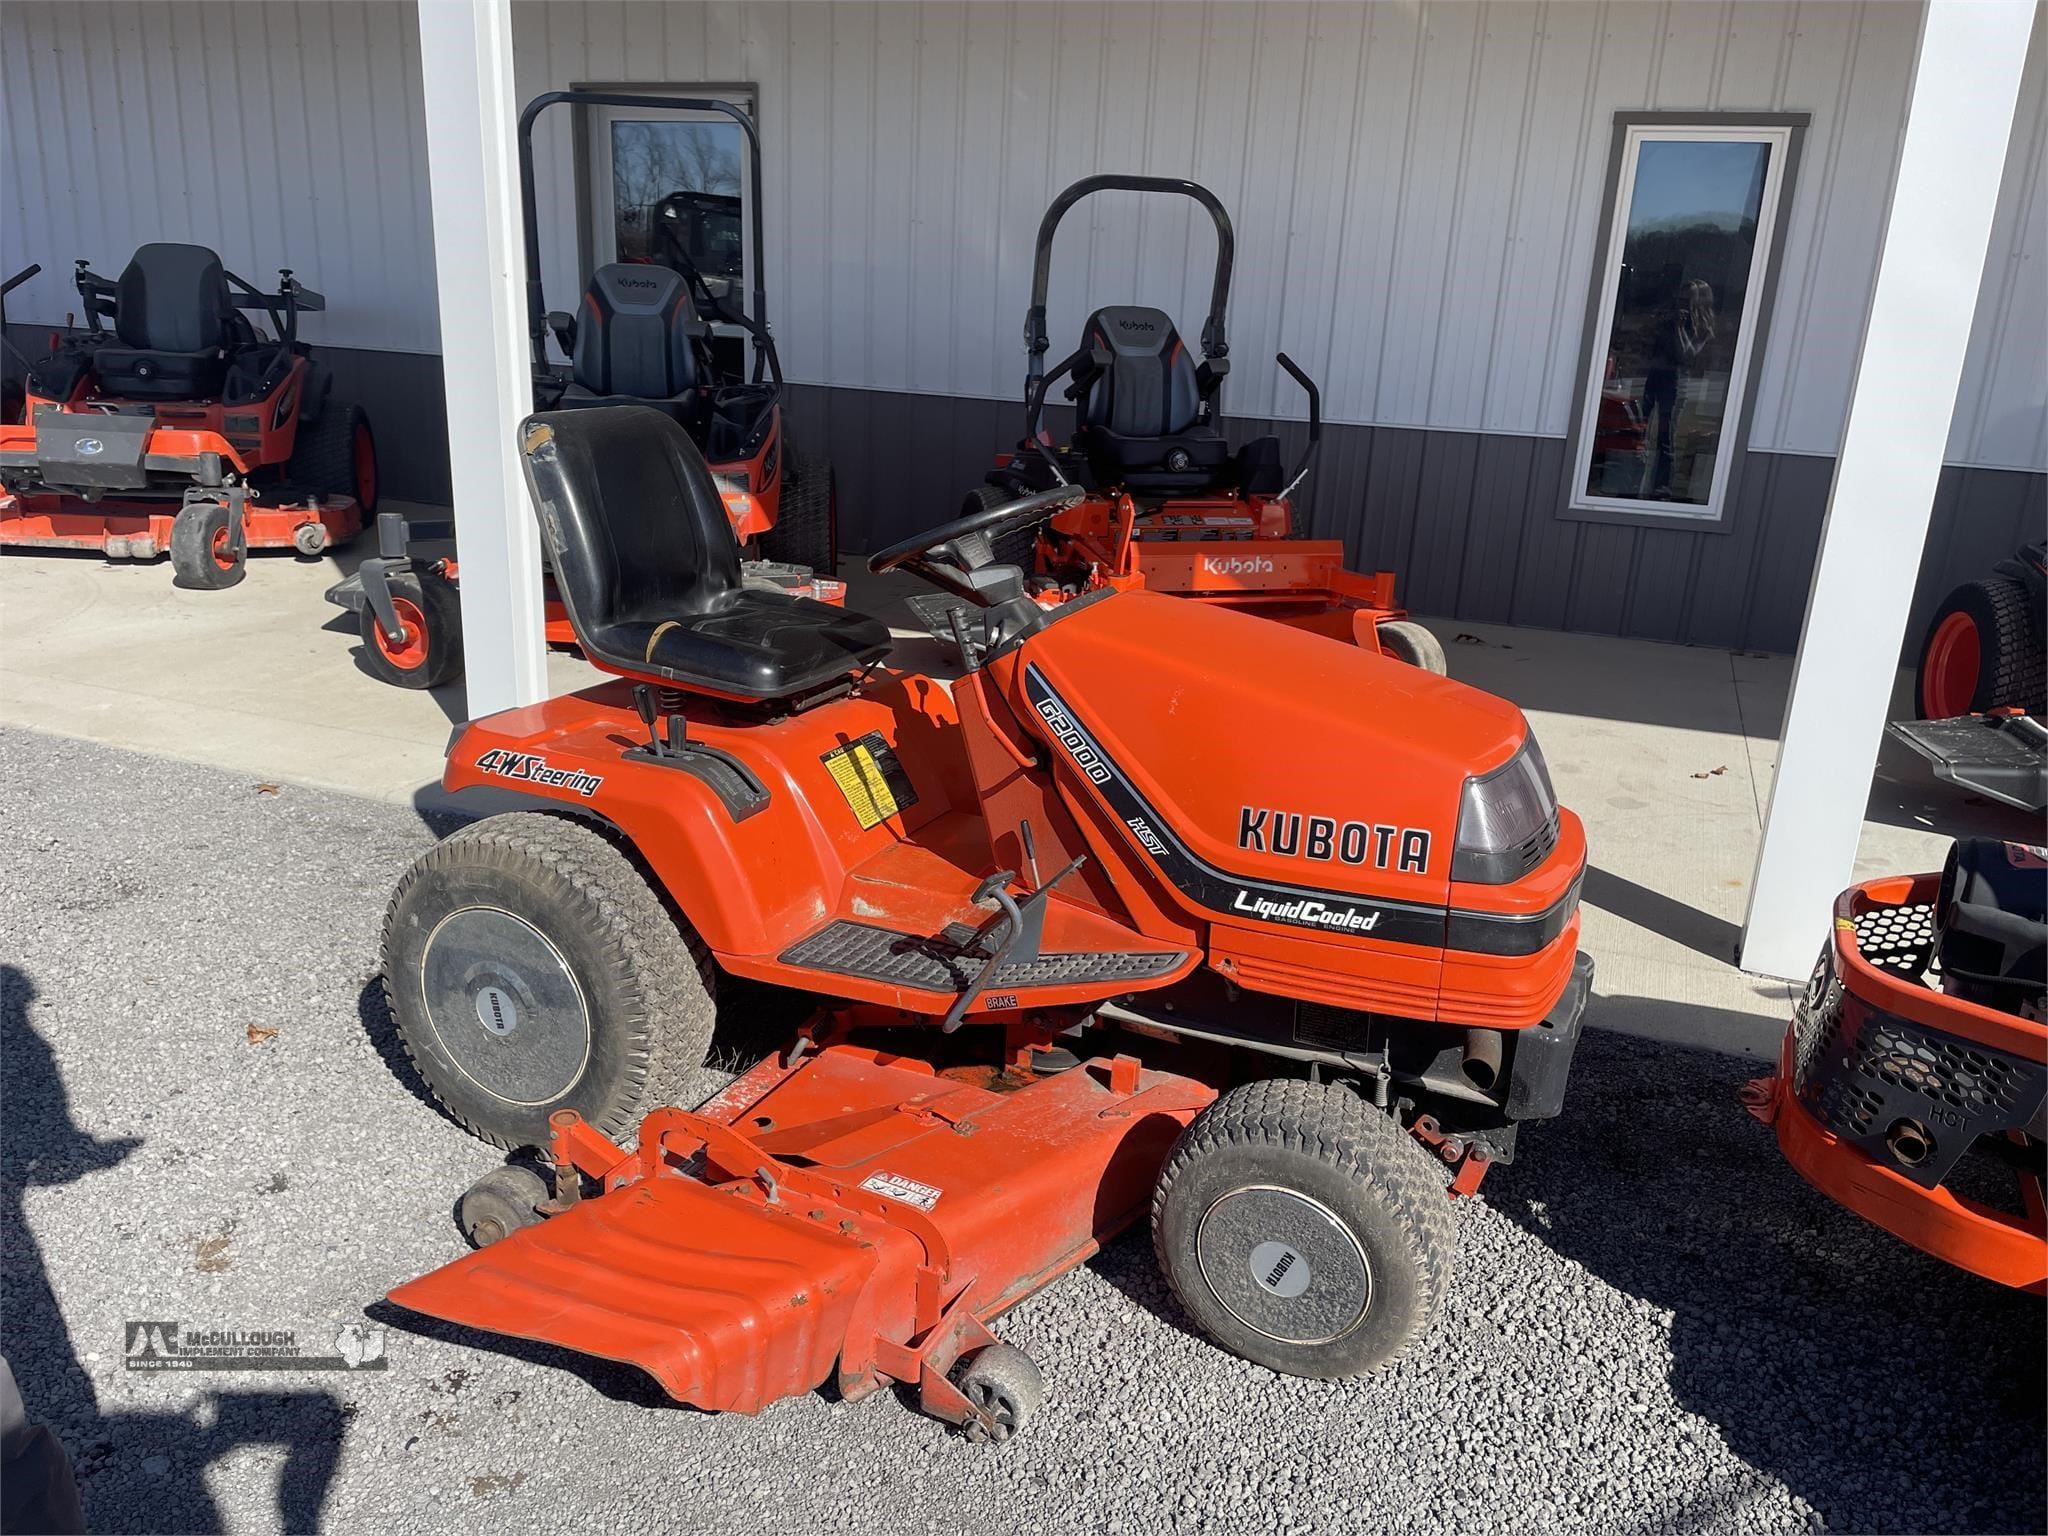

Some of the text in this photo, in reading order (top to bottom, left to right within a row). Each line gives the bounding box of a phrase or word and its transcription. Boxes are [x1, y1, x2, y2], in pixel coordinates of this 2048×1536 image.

[617, 277, 657, 289] Kubota
[1119, 319, 1154, 331] Kubota
[1204, 556, 1273, 575] Kubota
[1036, 698, 1112, 784] G2000
[1127, 817, 1169, 856] HST
[1238, 805, 1431, 874] KUBOTA
[1274, 916, 1356, 933] GASOLINE ENGINE
[489, 992, 505, 1029] KUBOTA
[986, 995, 1017, 1009] BRAKE
[1928, 1104, 1966, 1133] HOT
[889, 1175, 943, 1199] DANGER
[1265, 1251, 1296, 1287] KUBOTA
